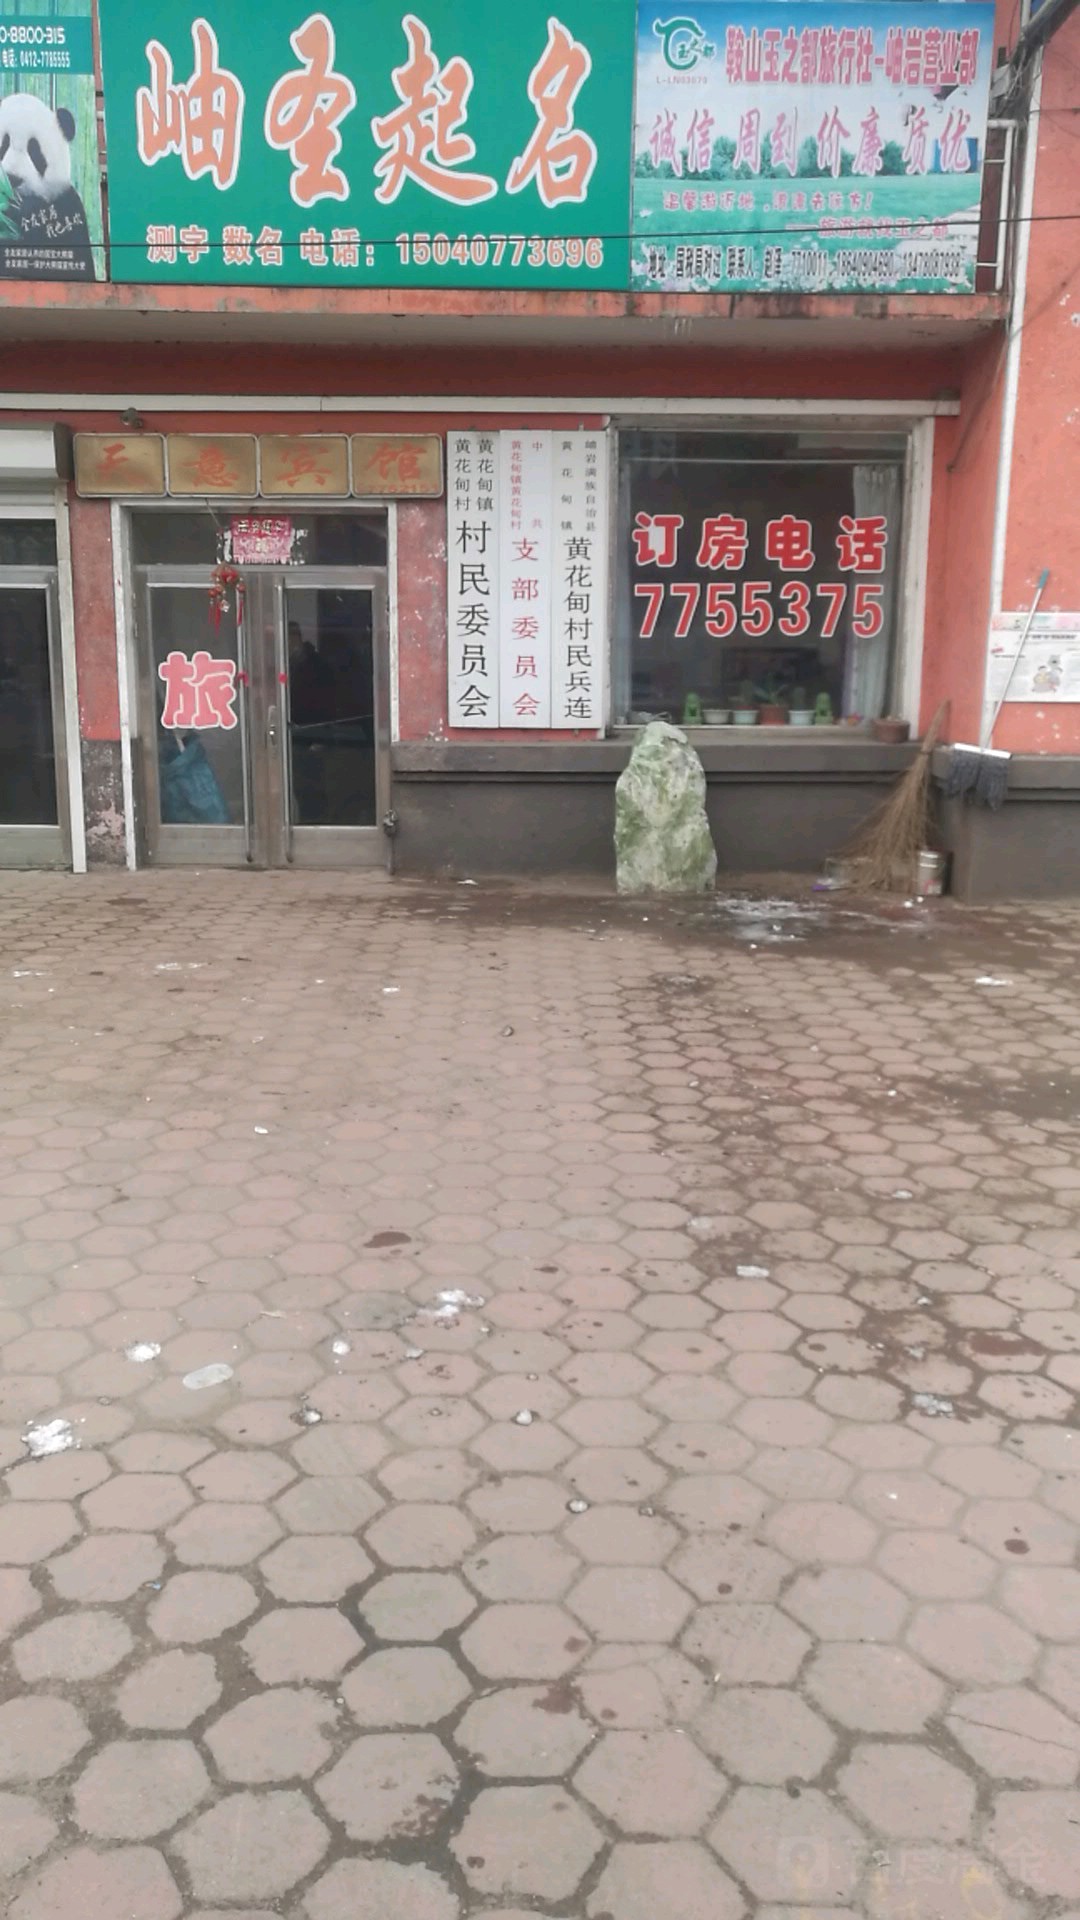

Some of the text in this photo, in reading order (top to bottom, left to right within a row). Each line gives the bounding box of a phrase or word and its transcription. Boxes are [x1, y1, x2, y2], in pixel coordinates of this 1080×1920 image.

[136, 13, 598, 206] 岫圣起名
[649, 108, 715, 177] 诚信
[733, 107, 798, 177] 周到
[817, 106, 885, 178] 价廉
[146, 226, 209, 264] 测字
[223, 226, 284, 266] 数名
[396, 233, 604, 269] 15040773696
[454, 438, 471, 511] 黄花甸村
[476, 438, 494, 511] 黄花甸镇
[560, 440, 573, 531] 黄花甸镇
[632, 511, 888, 573] 订房电话
[456, 520, 491, 718] 村民委员会
[511, 537, 541, 717] 支部委员会
[563, 537, 593, 719] 黄花甸村民兵连
[634, 581, 884, 638] 7755375
[158, 650, 238, 730] 旅
